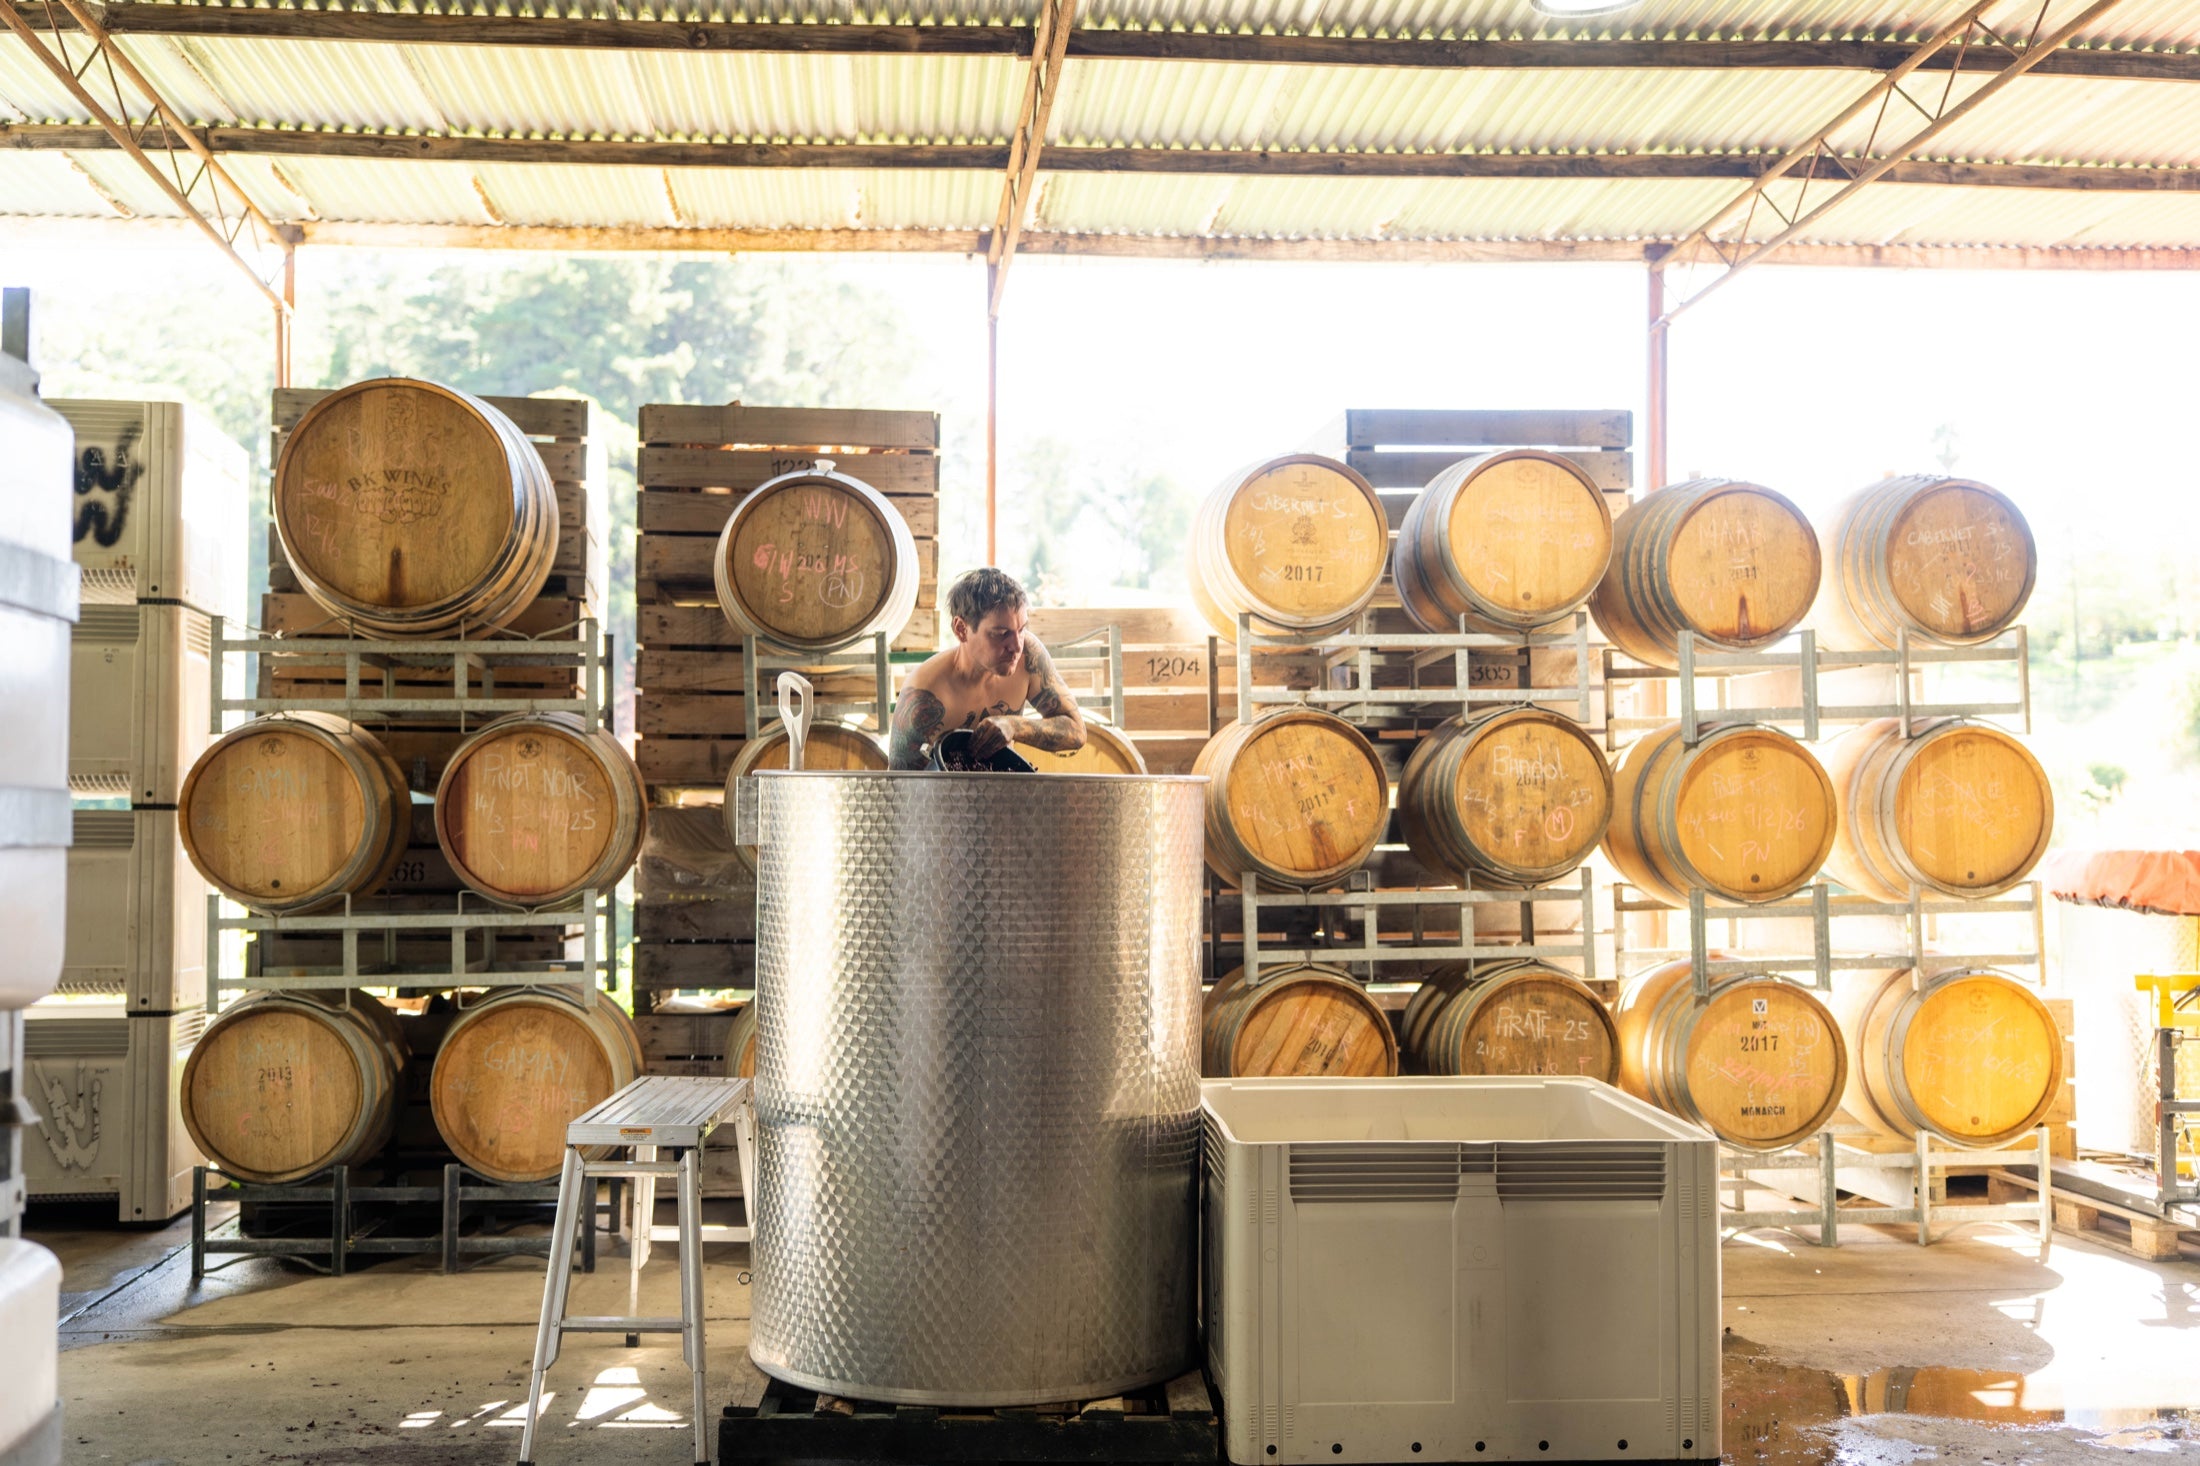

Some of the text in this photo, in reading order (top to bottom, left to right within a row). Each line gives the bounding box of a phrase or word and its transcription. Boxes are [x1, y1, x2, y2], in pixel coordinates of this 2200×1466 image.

[347, 468, 452, 496] BK WINES
[1284, 564, 1324, 582] 2017
[1147, 656, 1200, 677] 1204
[542, 767, 596, 803] NOIR
[1298, 792, 1330, 813] 2011
[1738, 840, 1770, 867] PN
[390, 861, 424, 881] 66
[1496, 1006, 1590, 1041] PIRATE 25
[1740, 1035, 1778, 1051] 2017
[483, 1040, 571, 1086] GAMAY
[1740, 1106, 1785, 1117] MONARCH
